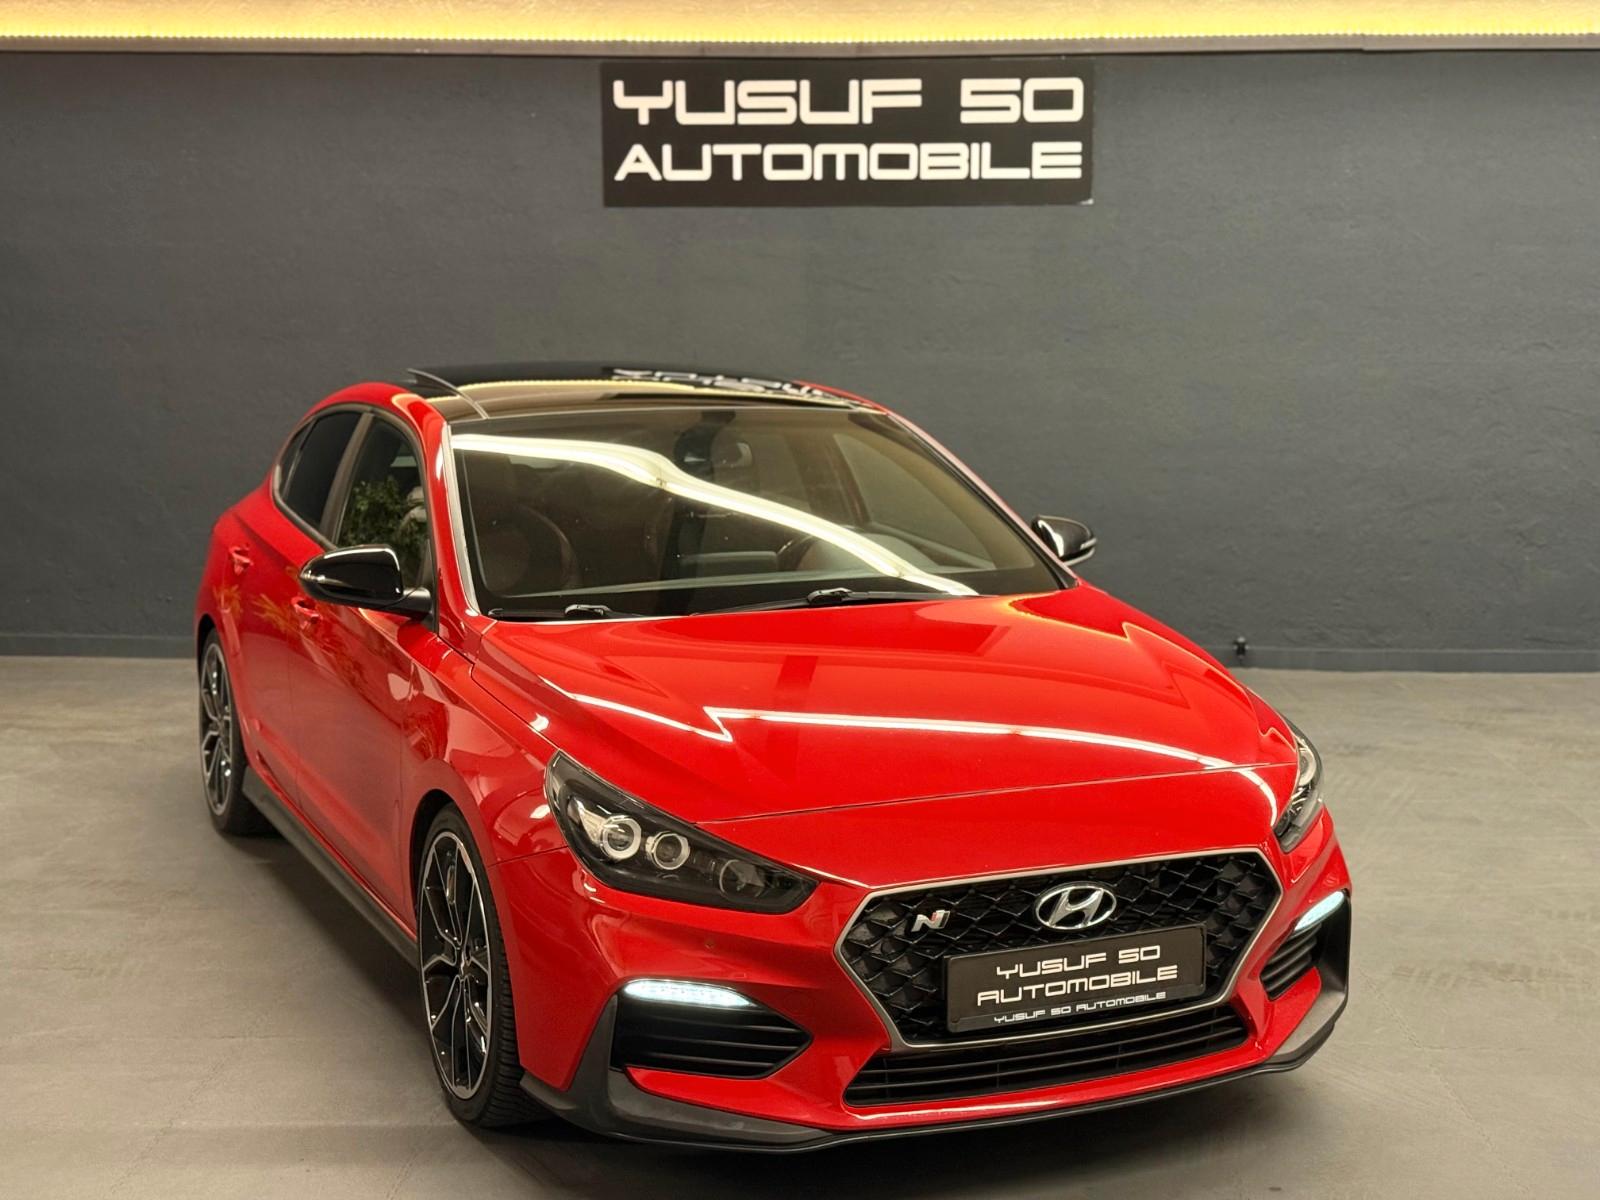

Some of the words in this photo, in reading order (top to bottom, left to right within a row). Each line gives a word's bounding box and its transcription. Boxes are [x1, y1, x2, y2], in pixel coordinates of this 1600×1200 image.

[613, 78, 922, 125] YUSUF
[614, 142, 1082, 182] AUTOMOBILE
[977, 965, 1178, 1006] AUTOMOBILE
[996, 952, 1107, 980] YUSUF
[993, 1009, 1046, 1024] YUSUF
[1075, 991, 1167, 1012] AUTOMOBILE
